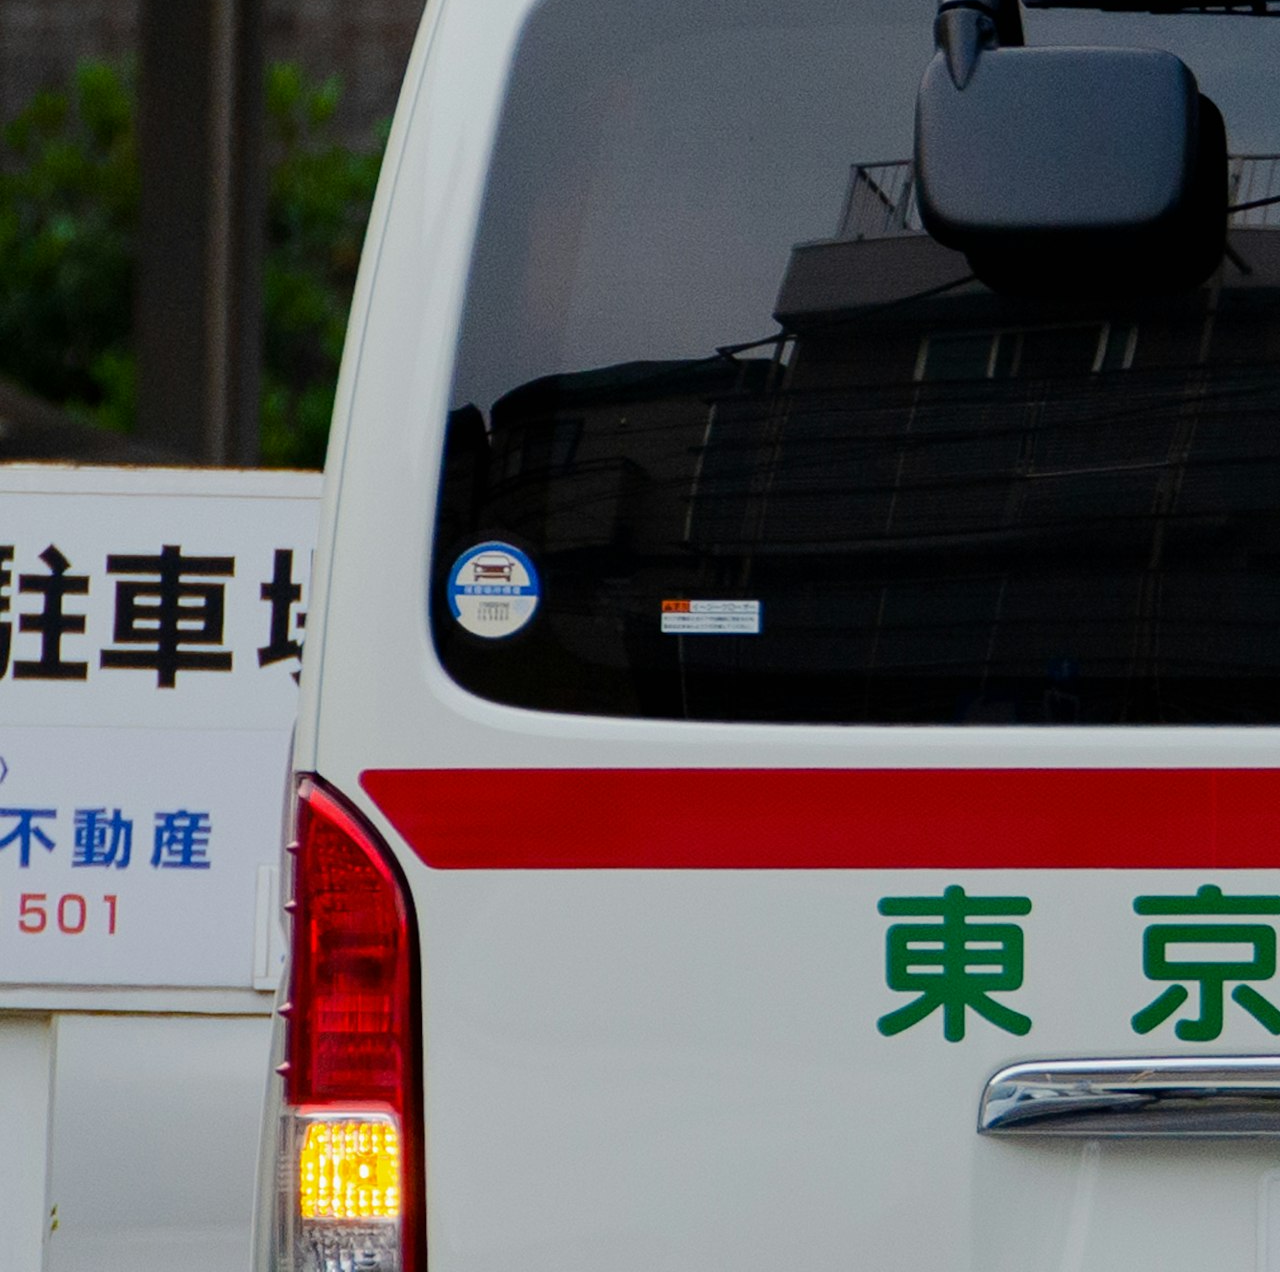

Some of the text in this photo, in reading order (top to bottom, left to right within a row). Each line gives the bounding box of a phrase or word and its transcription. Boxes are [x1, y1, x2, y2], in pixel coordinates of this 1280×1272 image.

[0, 807, 212, 871] 不動産
[18, 892, 118, 936] 501
